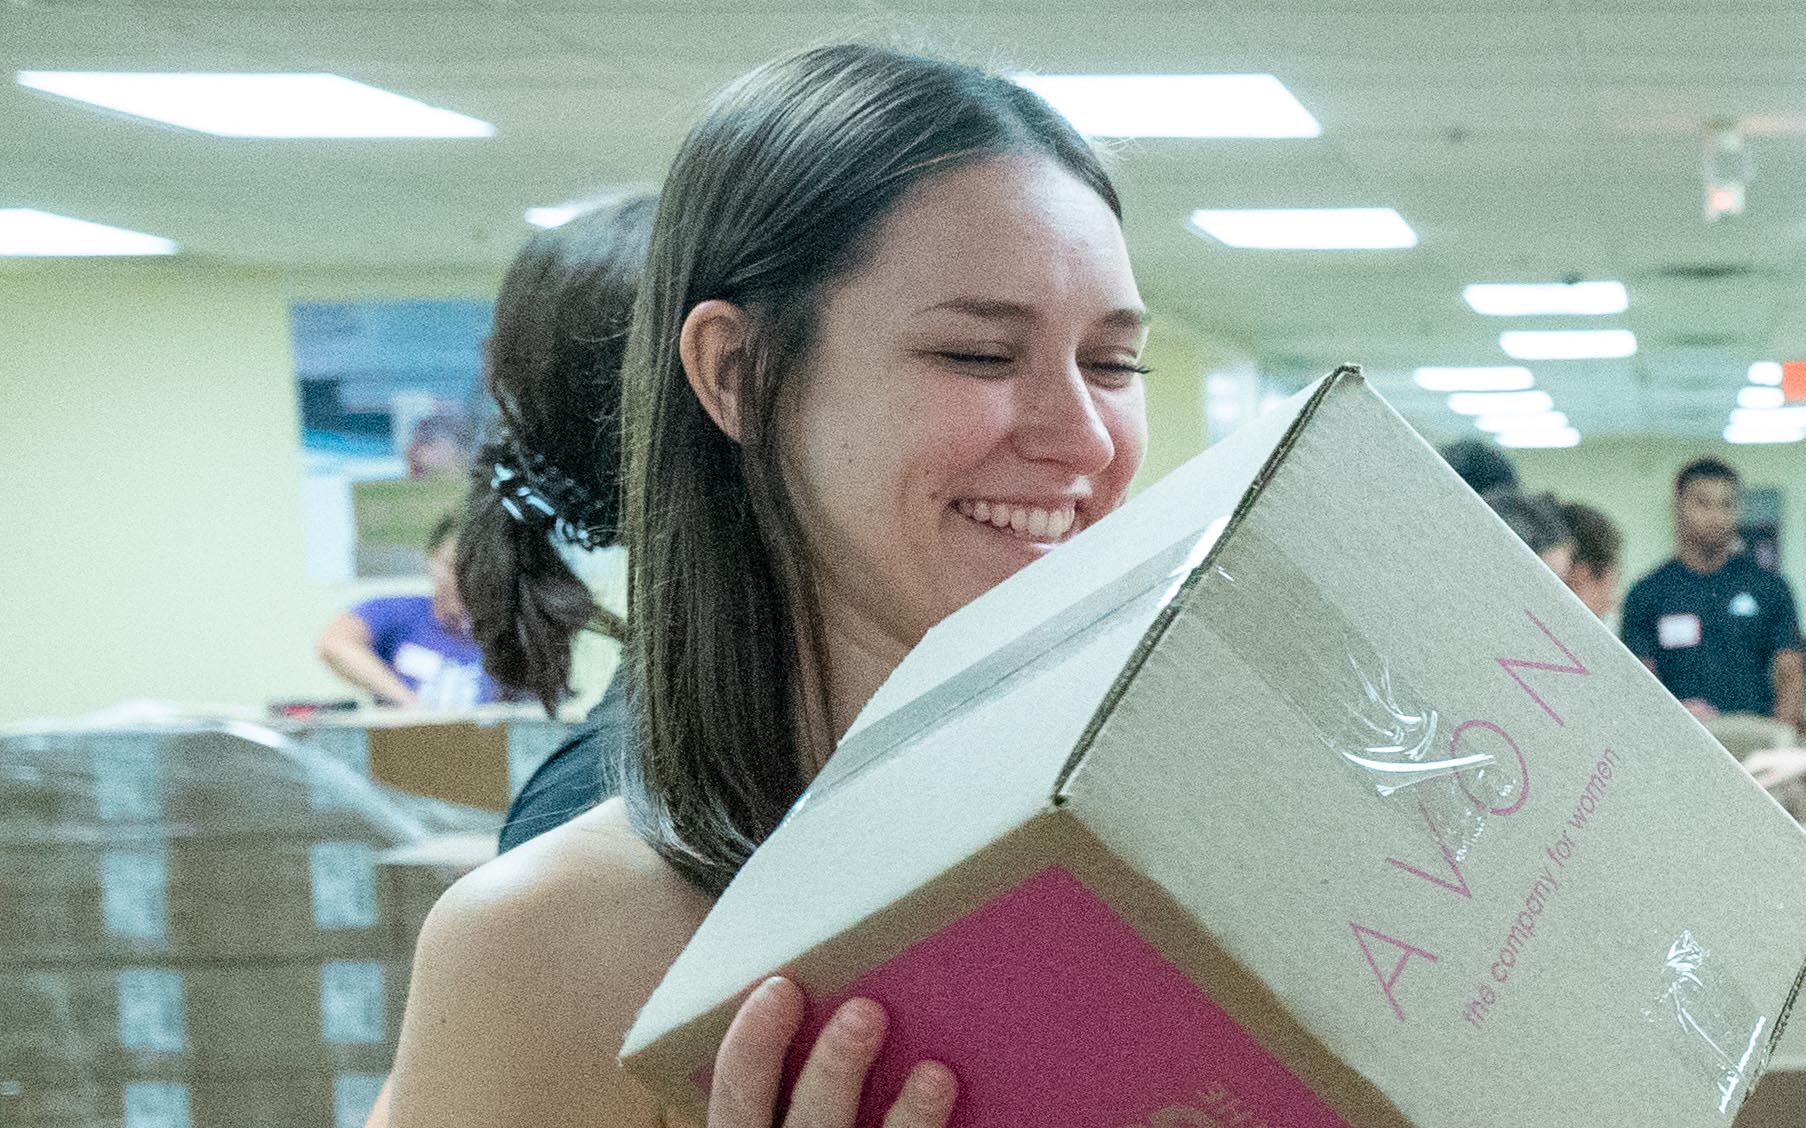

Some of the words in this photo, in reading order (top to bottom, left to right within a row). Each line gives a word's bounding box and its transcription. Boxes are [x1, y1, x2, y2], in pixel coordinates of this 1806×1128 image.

[1348, 608, 1592, 1021] AVON
[1461, 982, 1497, 1031] the
[1489, 866, 1560, 986] company
[1544, 828, 1576, 870] for
[1567, 744, 1622, 832] women
